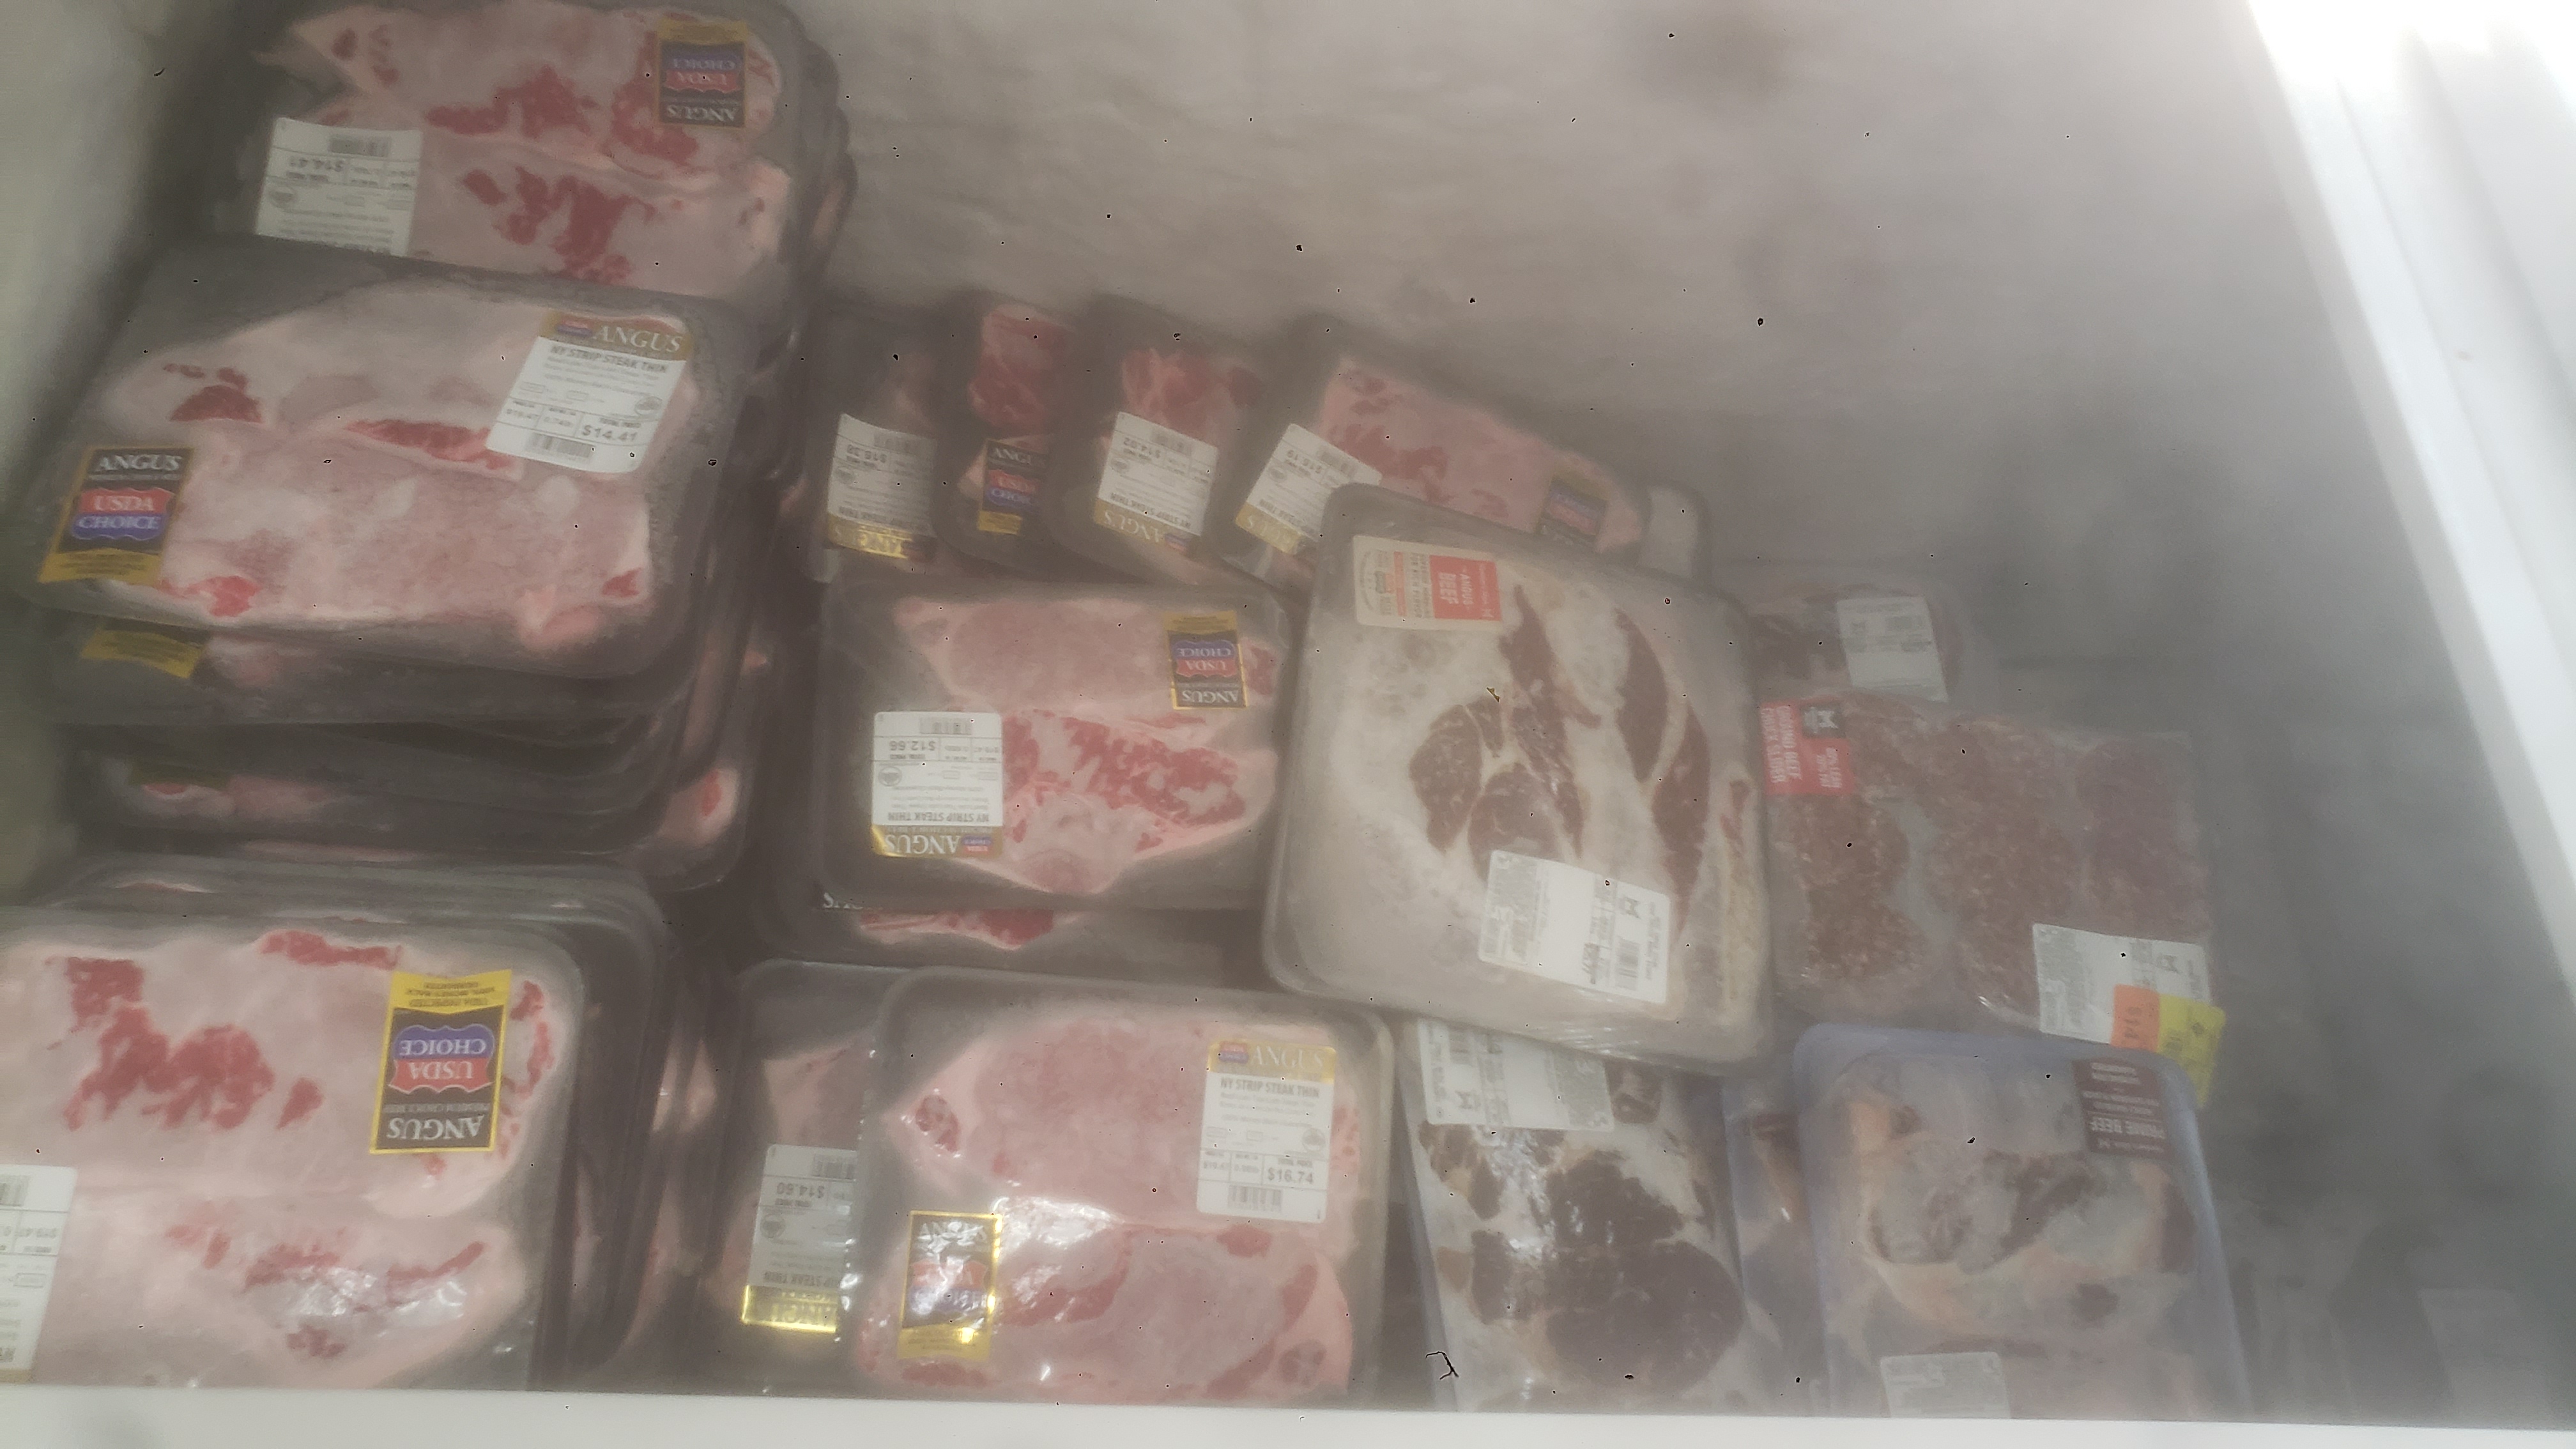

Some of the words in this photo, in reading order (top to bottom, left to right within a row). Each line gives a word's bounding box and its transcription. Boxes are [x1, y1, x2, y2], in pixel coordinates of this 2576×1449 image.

[666, 103, 737, 123] ANGUS
[594, 325, 683, 354] ANGUS
[581, 424, 640, 442] $14.41
[96, 454, 183, 472] ANGUS
[93, 495, 155, 512] USDA
[78, 515, 161, 530] CHOICE
[1103, 510, 1164, 543] ANGUS
[1437, 572, 1459, 605] BEEF
[1459, 572, 1475, 606] ANGUS
[1176, 647, 1232, 657] CHOICE
[1184, 659, 1227, 671] USDA
[1181, 690, 1239, 704] ANGUS
[889, 740, 937, 751] $12.66
[914, 811, 945, 822] STEAK
[946, 811, 975, 823] STRIP
[976, 811, 990, 823] NY
[885, 834, 962, 855] ANGUS
[399, 1038, 486, 1056] CHOICE
[1253, 1045, 1324, 1068] ANGUS
[407, 1060, 473, 1080] USDA
[386, 1114, 485, 1141] ANGUS
[1268, 1167, 1314, 1184] $16.74
